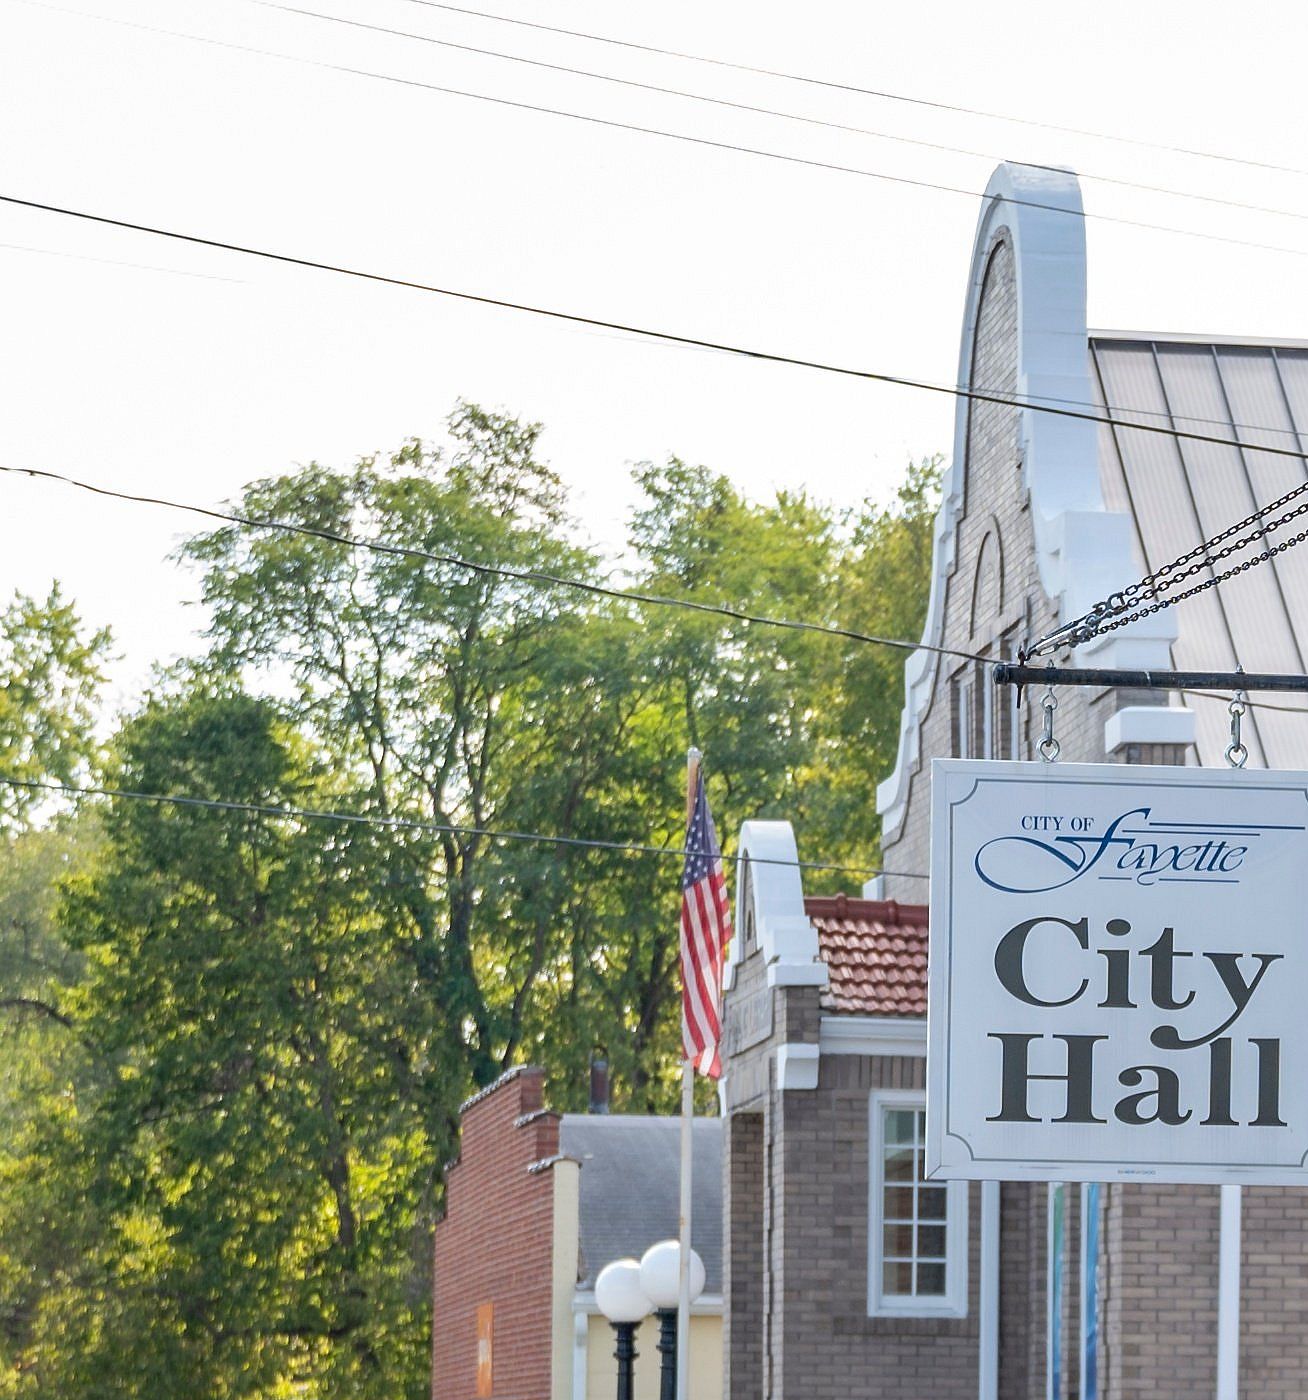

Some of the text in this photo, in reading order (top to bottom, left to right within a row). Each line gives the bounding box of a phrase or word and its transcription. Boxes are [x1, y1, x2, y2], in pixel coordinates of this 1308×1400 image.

[1021, 815, 1095, 832] CITY OF
[994, 916, 1285, 1050] City
[985, 1033, 1288, 1126] Hall
